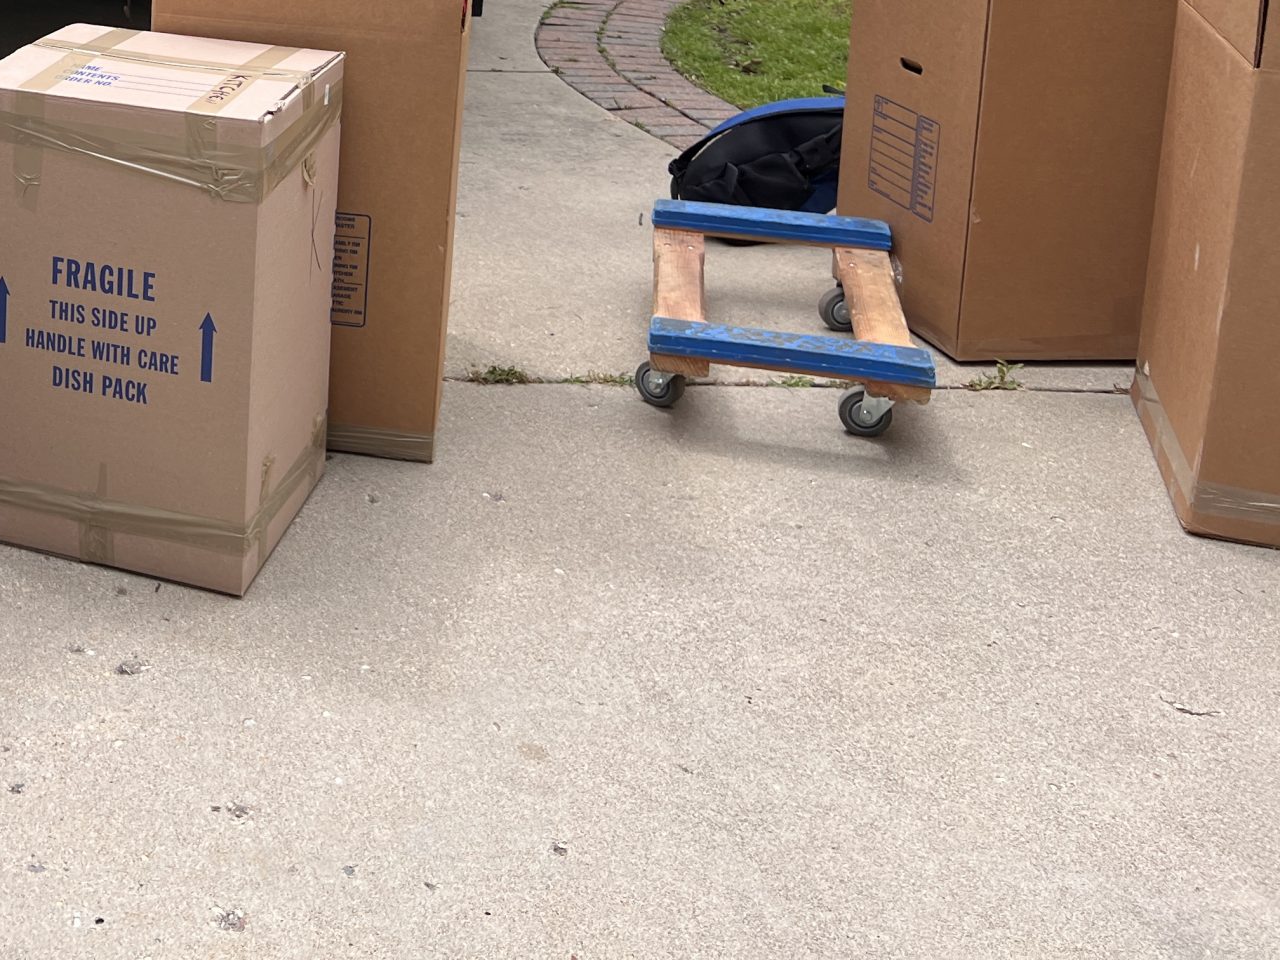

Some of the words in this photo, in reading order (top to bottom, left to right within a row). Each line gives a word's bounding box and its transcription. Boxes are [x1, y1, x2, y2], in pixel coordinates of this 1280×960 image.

[52, 255, 156, 302] FRAGILE
[49, 299, 85, 324] THIS
[91, 307, 129, 332] SIDE
[135, 315, 157, 336] UP
[25, 327, 86, 358] HANDLE
[91, 340, 131, 366] WITH
[137, 348, 179, 375] CARE
[52, 365, 94, 394] DISH
[102, 375, 148, 405] PACK
